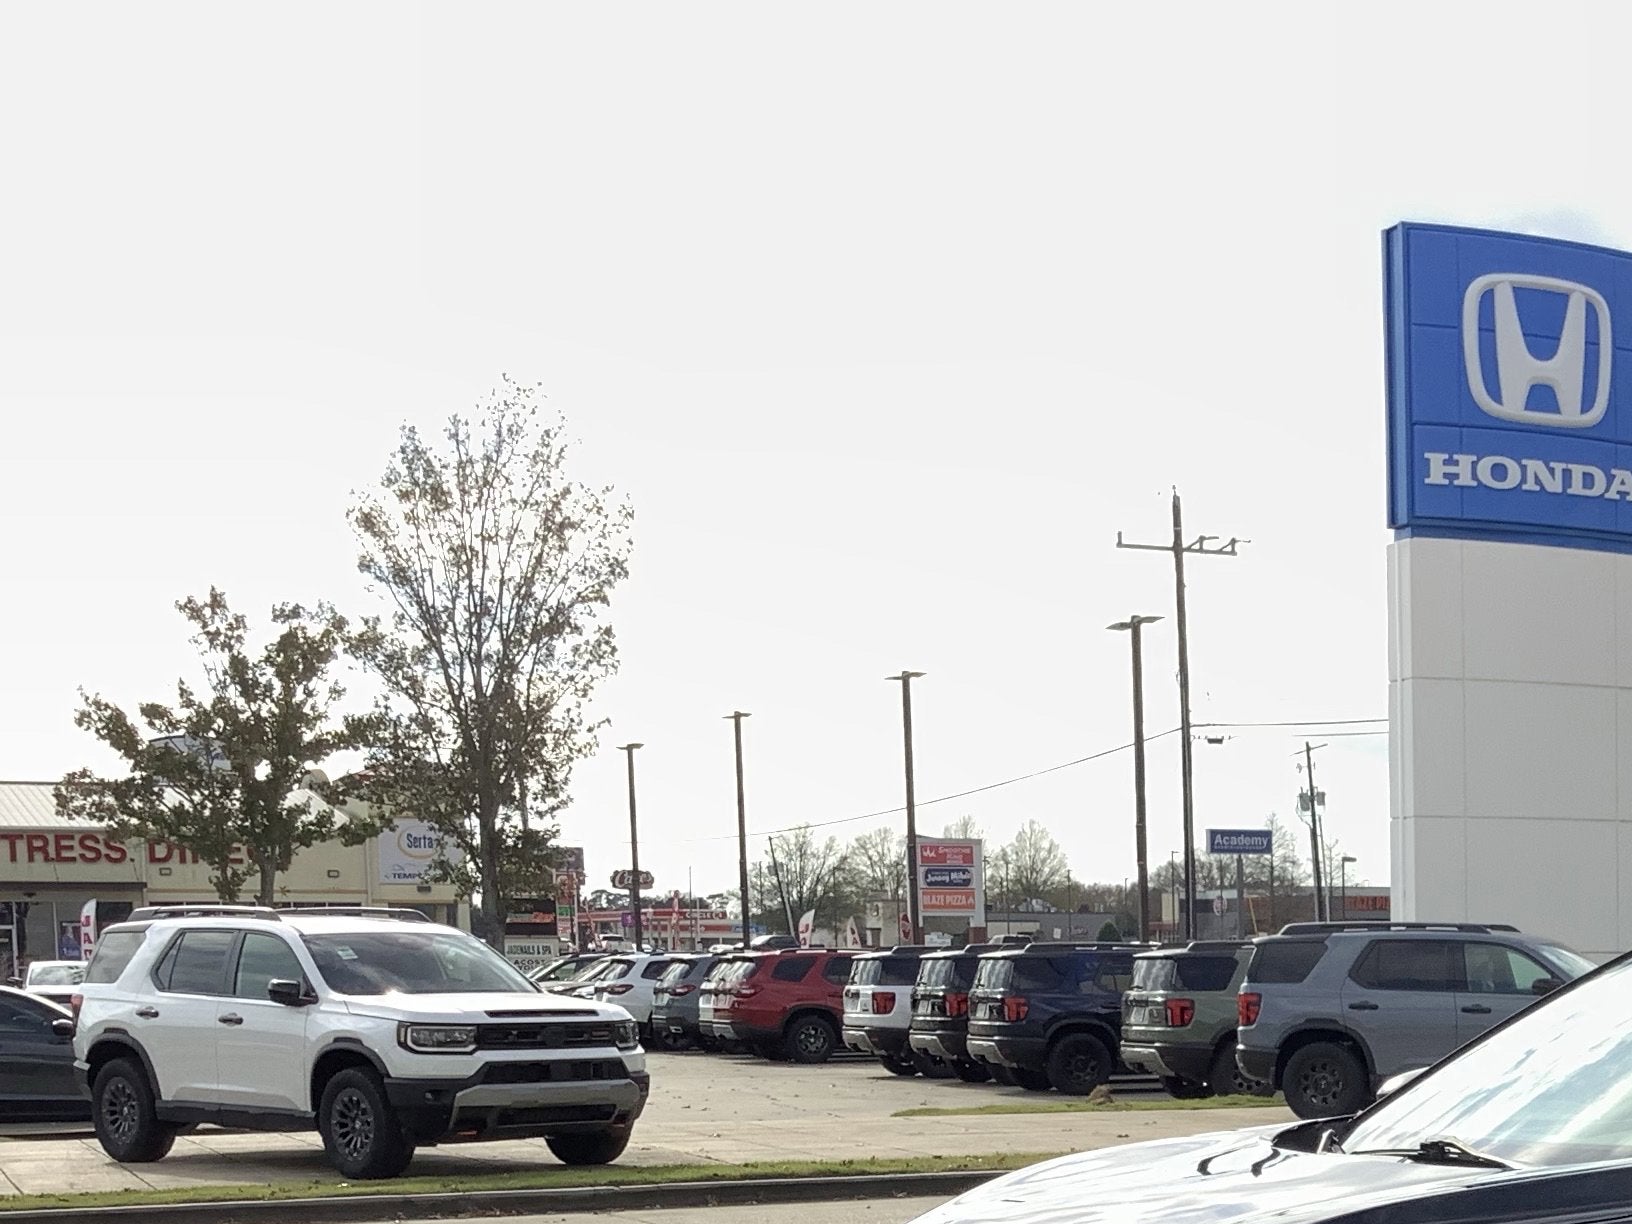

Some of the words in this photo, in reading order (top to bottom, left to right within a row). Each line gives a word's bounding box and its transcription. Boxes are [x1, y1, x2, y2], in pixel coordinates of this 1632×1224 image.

[0, 834, 127, 864] TRESS
[406, 833, 434, 849] Serta
[1214, 834, 1269, 849] Academy
